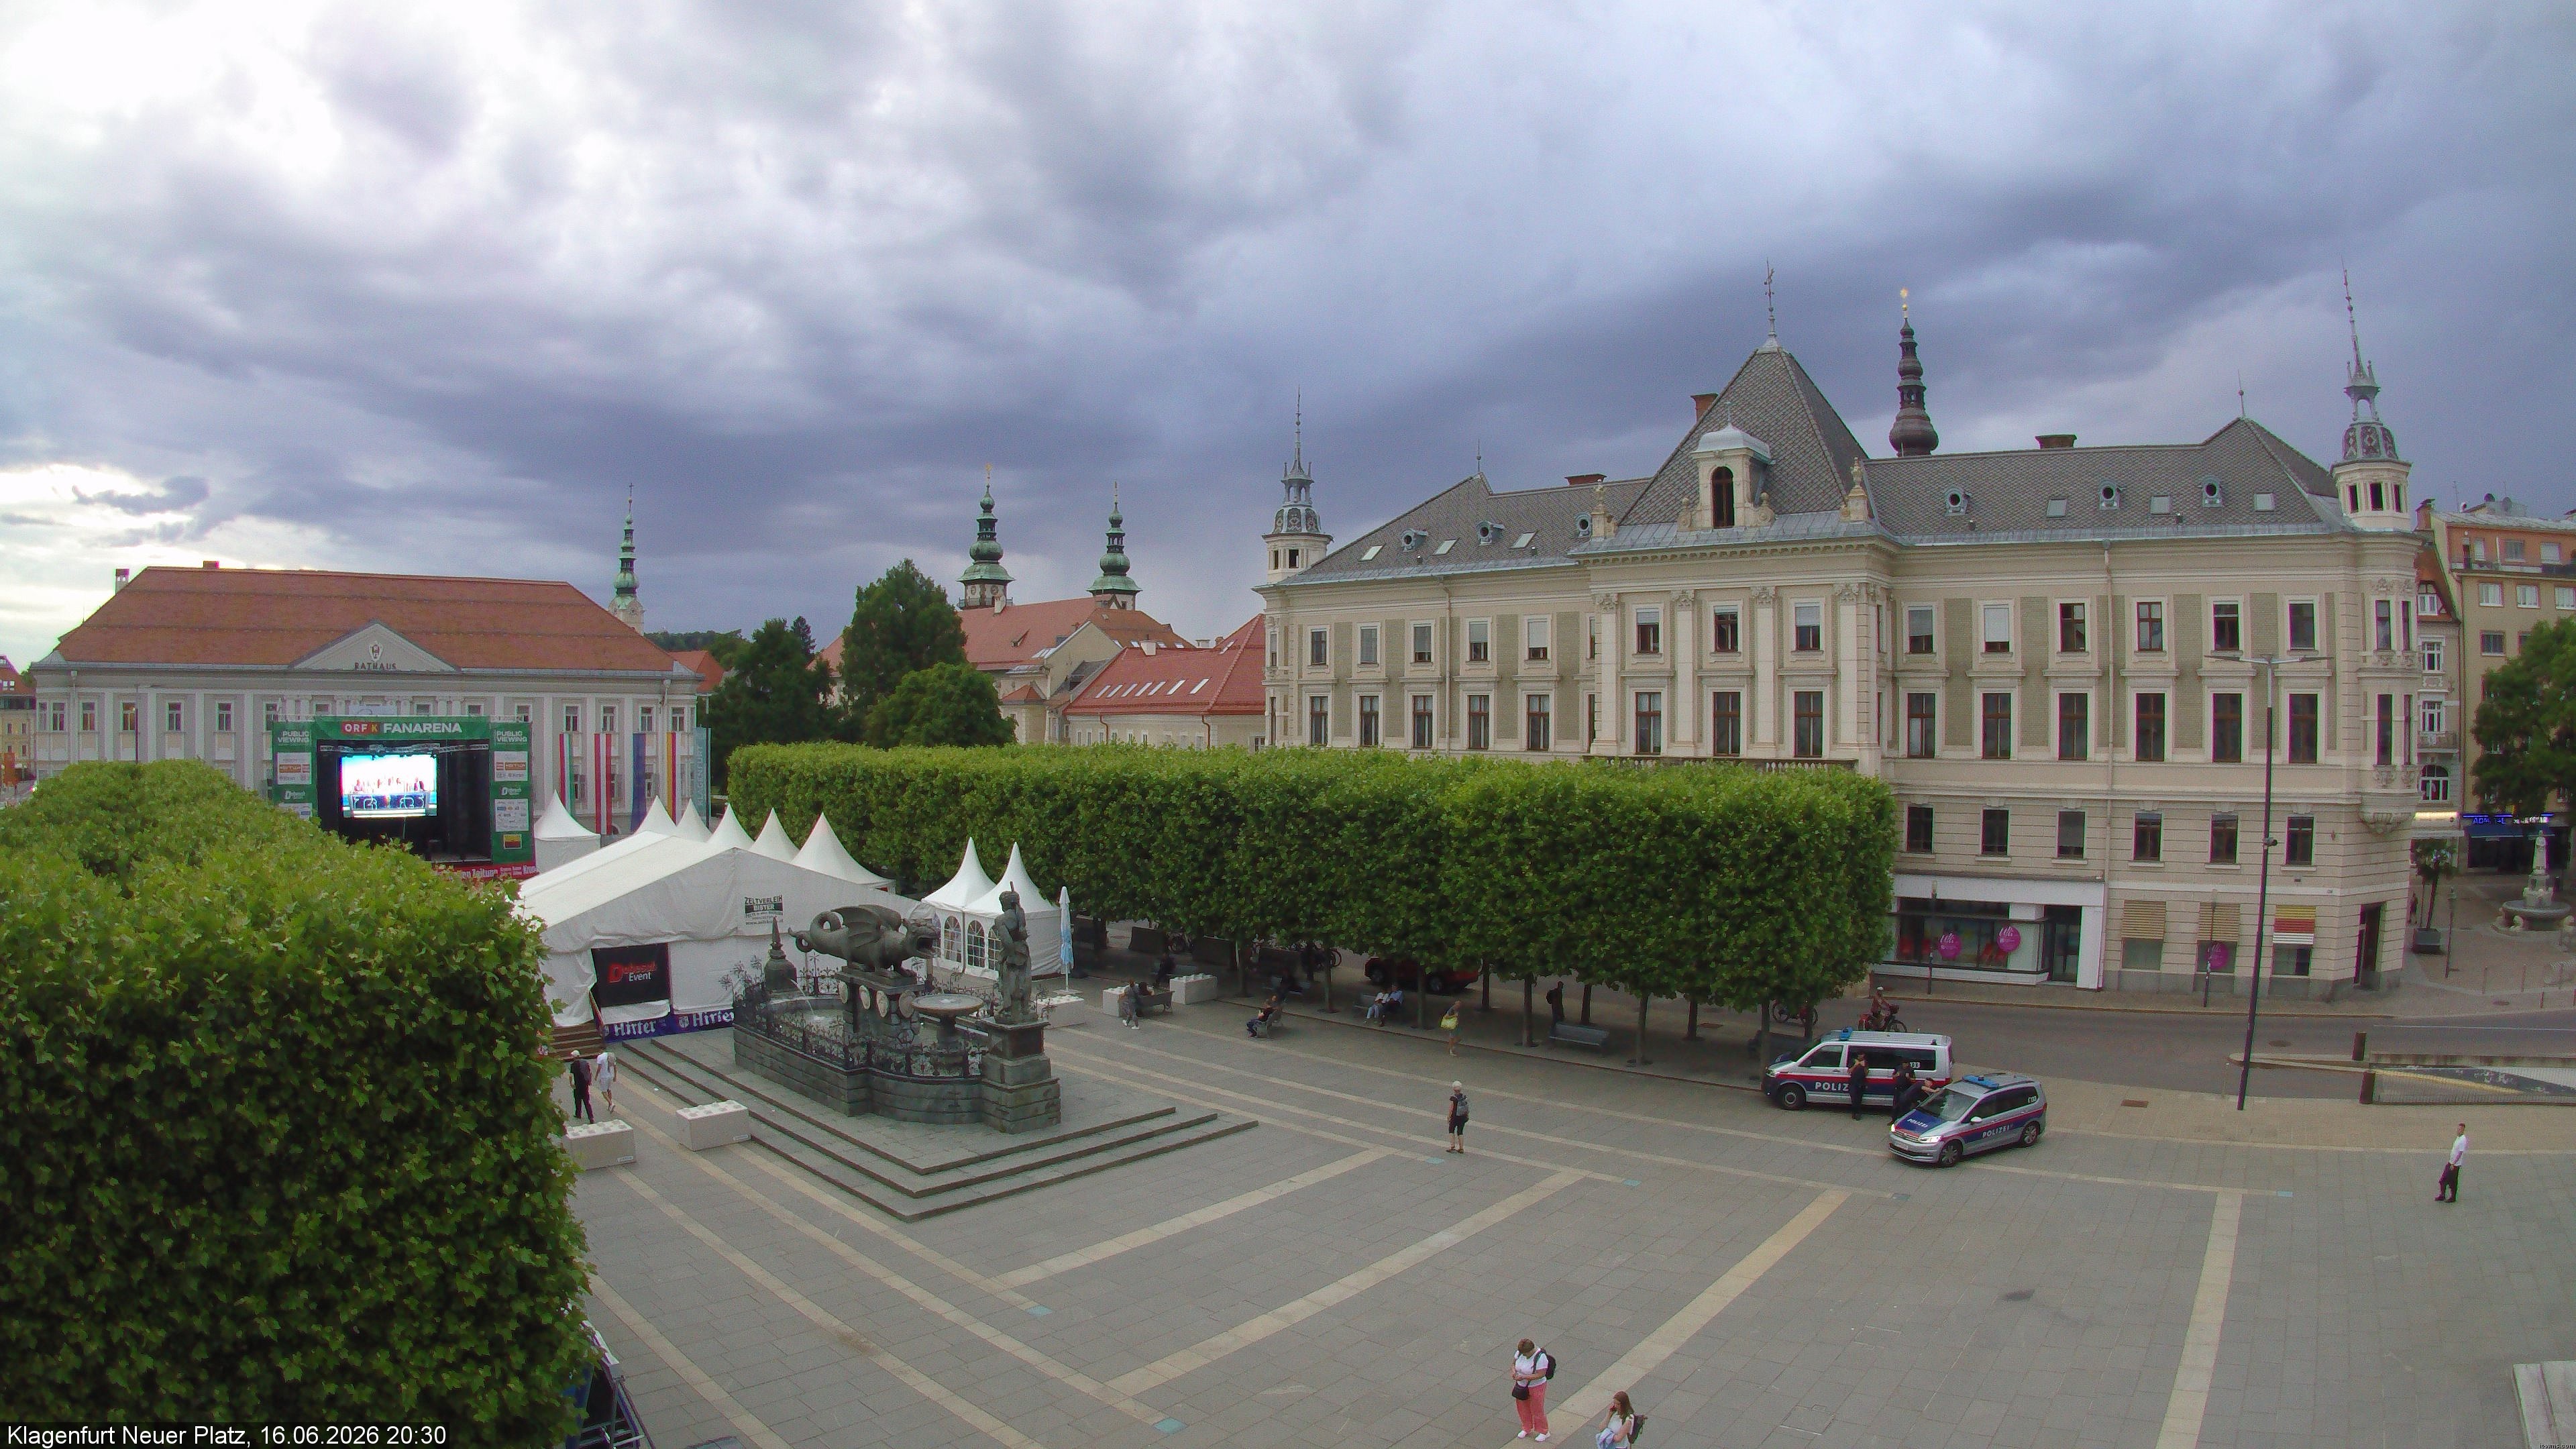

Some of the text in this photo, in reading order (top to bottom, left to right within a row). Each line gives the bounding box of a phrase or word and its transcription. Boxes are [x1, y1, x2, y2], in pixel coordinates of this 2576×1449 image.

[354, 662, 396, 670] RATHAUS
[344, 723, 368, 732] ORF
[384, 722, 462, 733] FANARENA
[745, 894, 783, 904] ZELTVERLEIH
[629, 971, 651, 982] Event
[614, 1020, 656, 1036] Hirter
[1815, 1082, 1849, 1091] POLIZ
[1907, 1118, 1929, 1128] POLIZEI
[1982, 1125, 2010, 1138] POLIZEI
